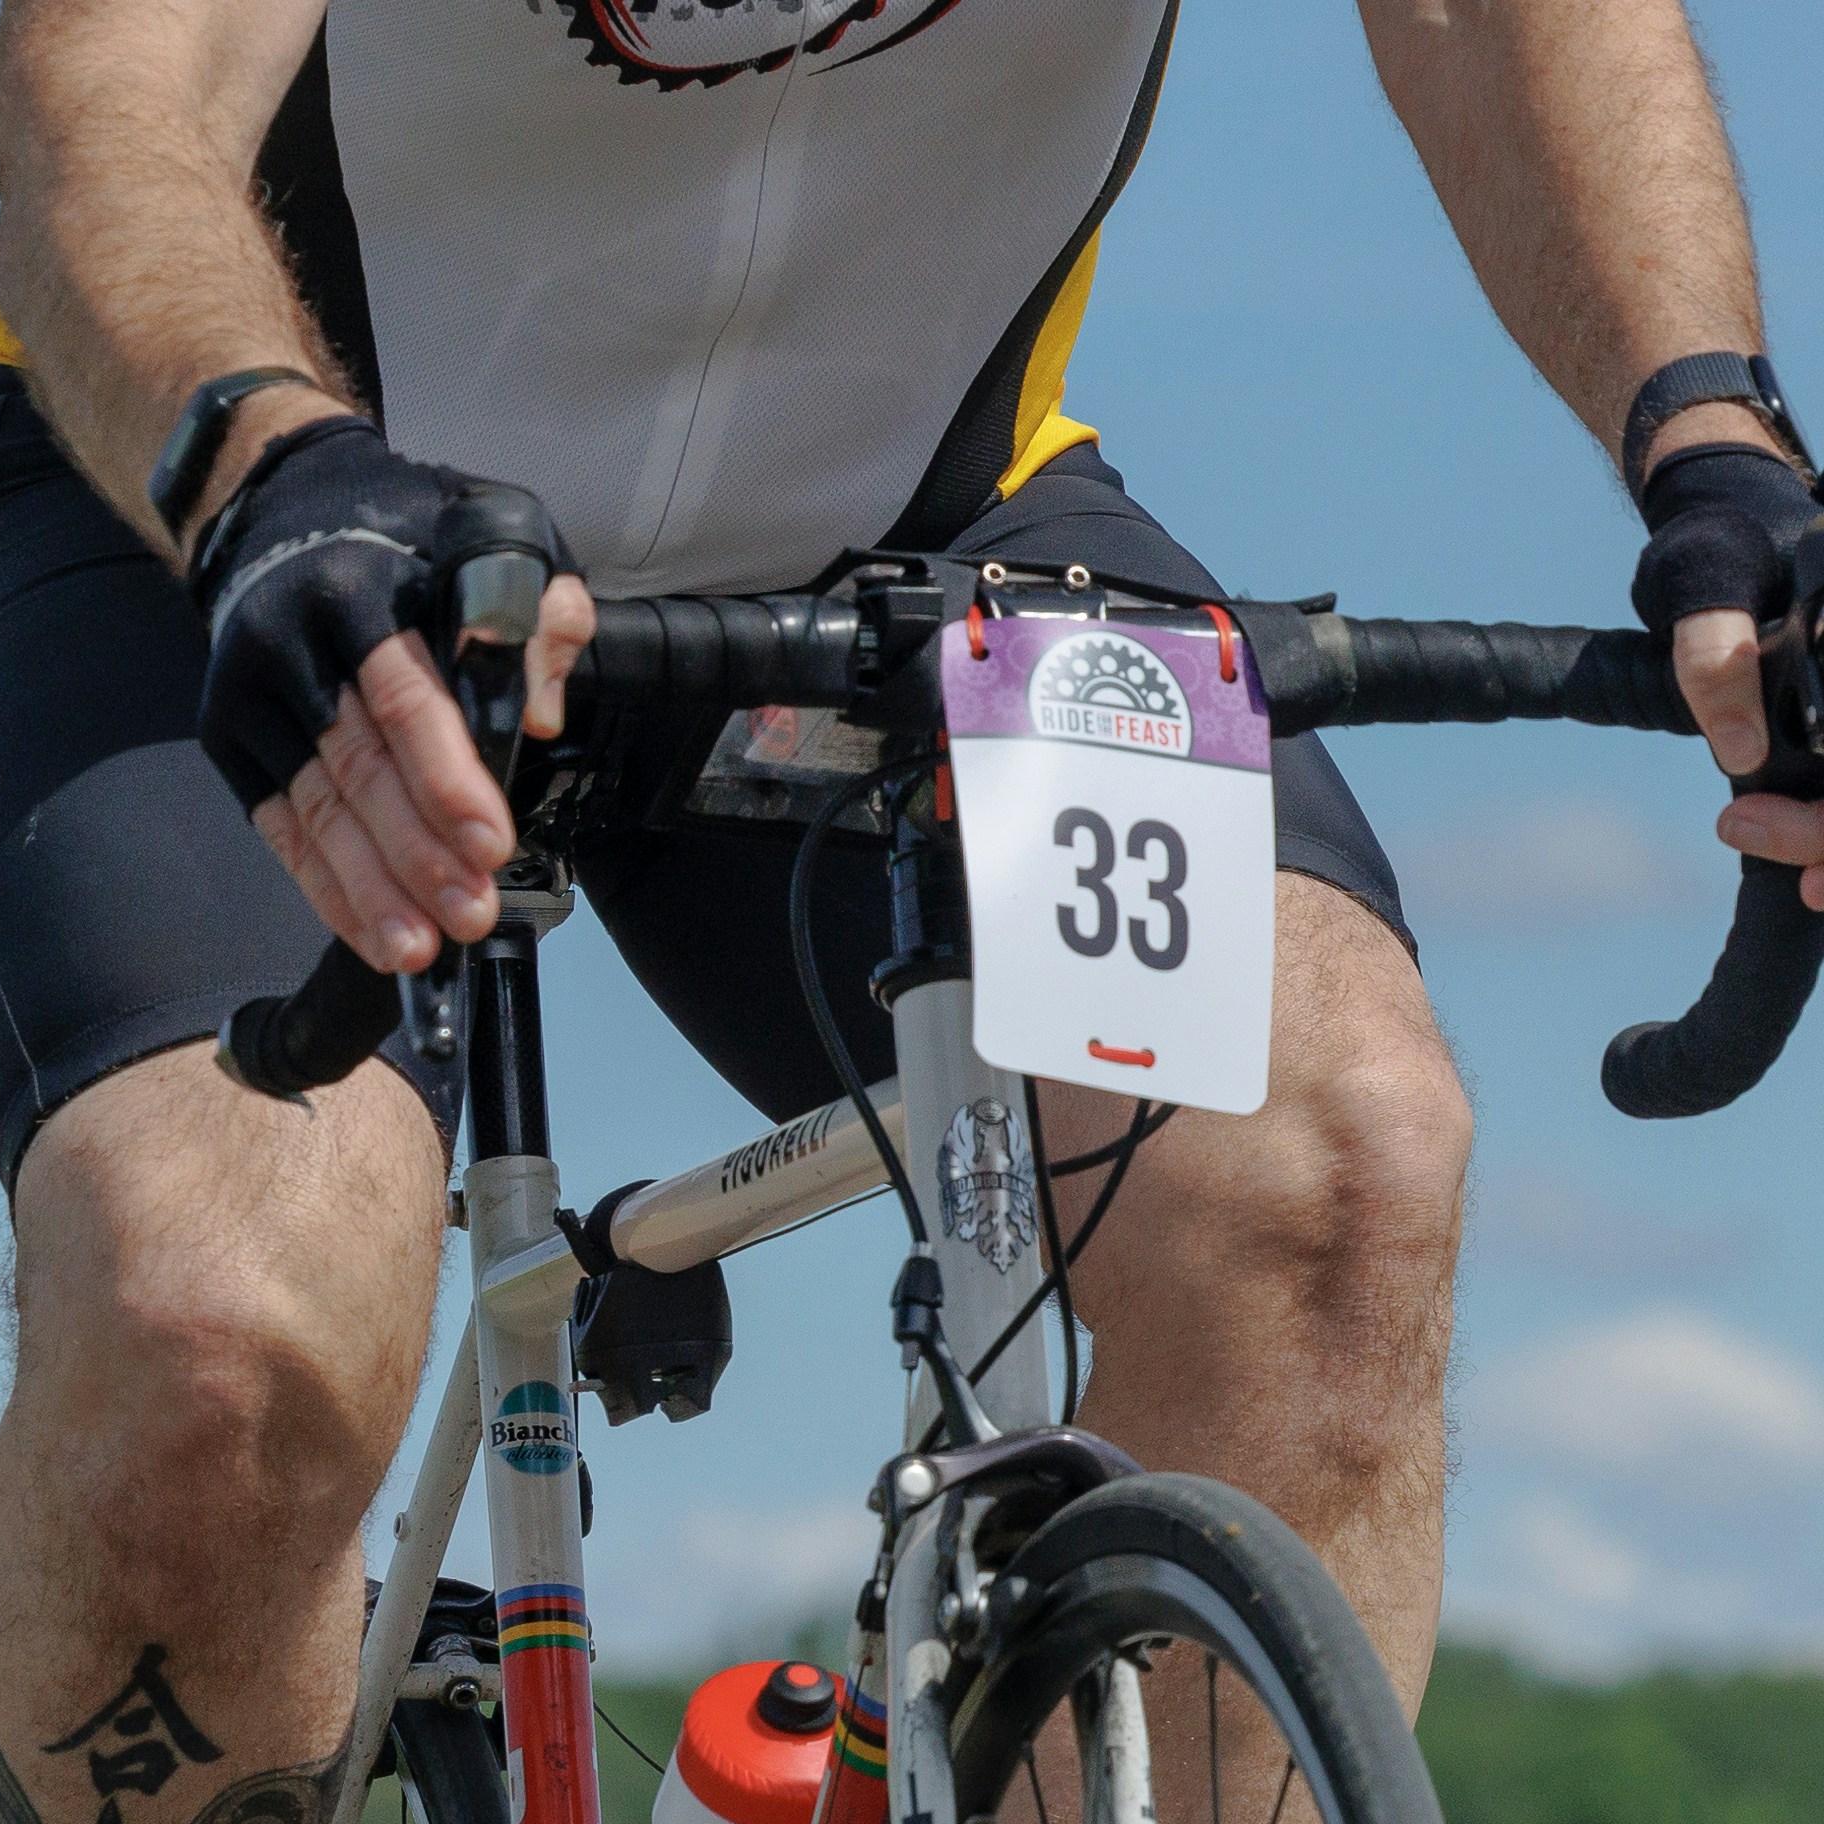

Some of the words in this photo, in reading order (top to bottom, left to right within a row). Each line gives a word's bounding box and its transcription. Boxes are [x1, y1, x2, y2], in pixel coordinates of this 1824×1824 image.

[1041, 707, 1094, 734] RIDE
[1115, 714, 1182, 748] FEAST
[1052, 806, 1189, 971] 33
[490, 1418, 575, 1448] Bianch
